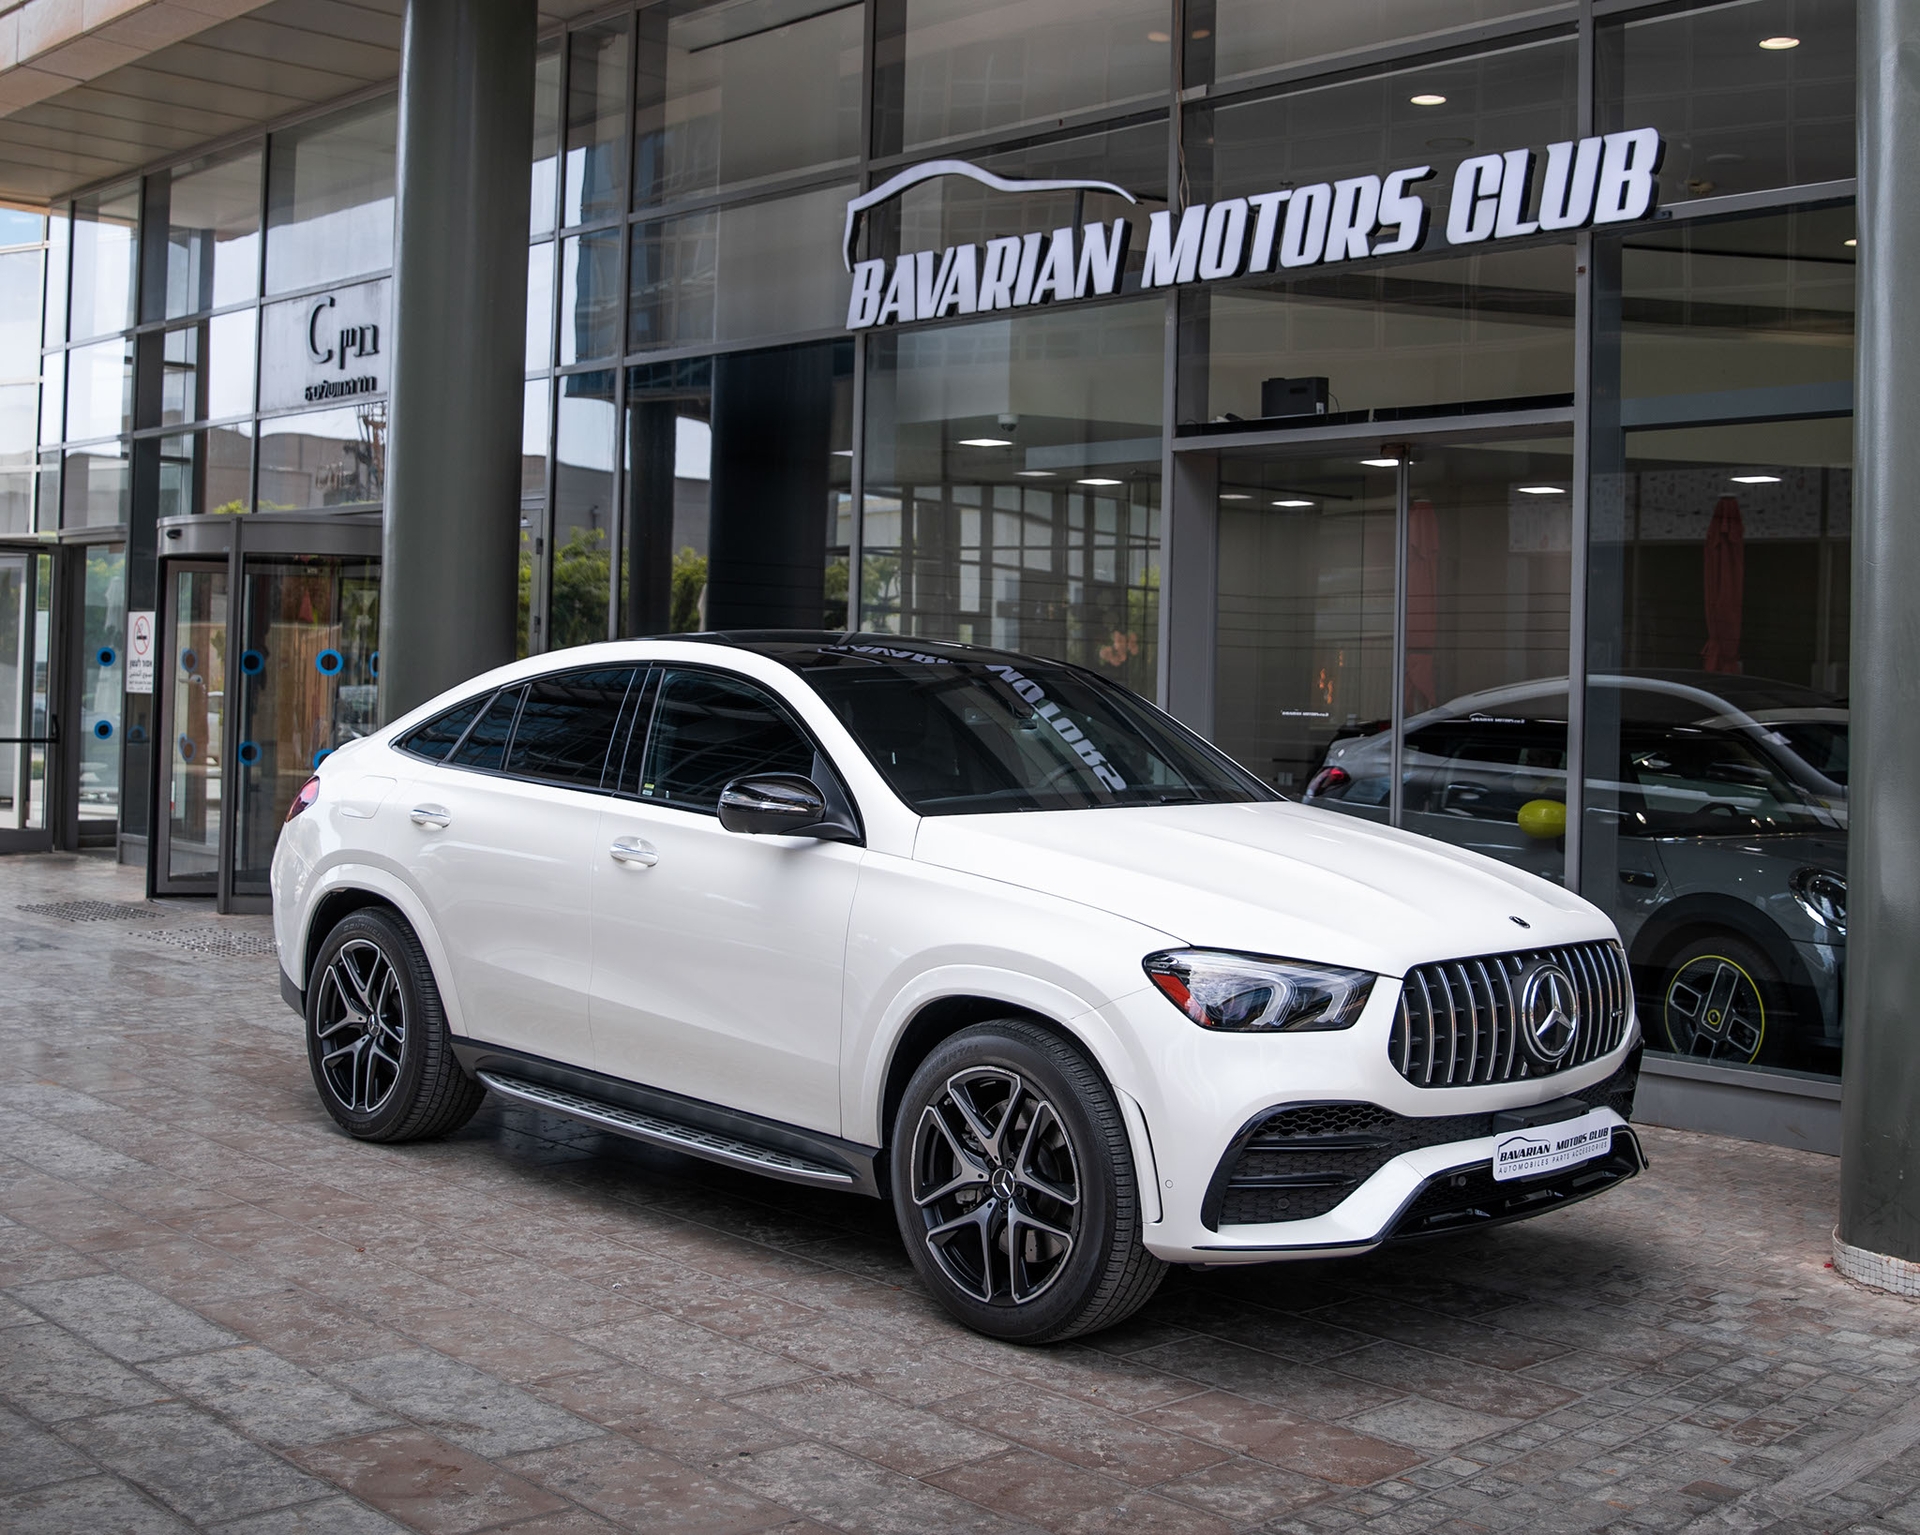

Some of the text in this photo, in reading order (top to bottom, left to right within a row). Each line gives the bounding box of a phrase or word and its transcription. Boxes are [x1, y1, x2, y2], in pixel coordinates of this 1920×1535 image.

[847, 127, 1661, 330] BAVARIAN MOTORS CLUB
[306, 295, 336, 364] C
[1498, 1141, 1608, 1174] AUTOMOBILES PARTS ACCESSORIES
[1500, 1127, 1609, 1162] BAVARIAN MOTORS CLUB
